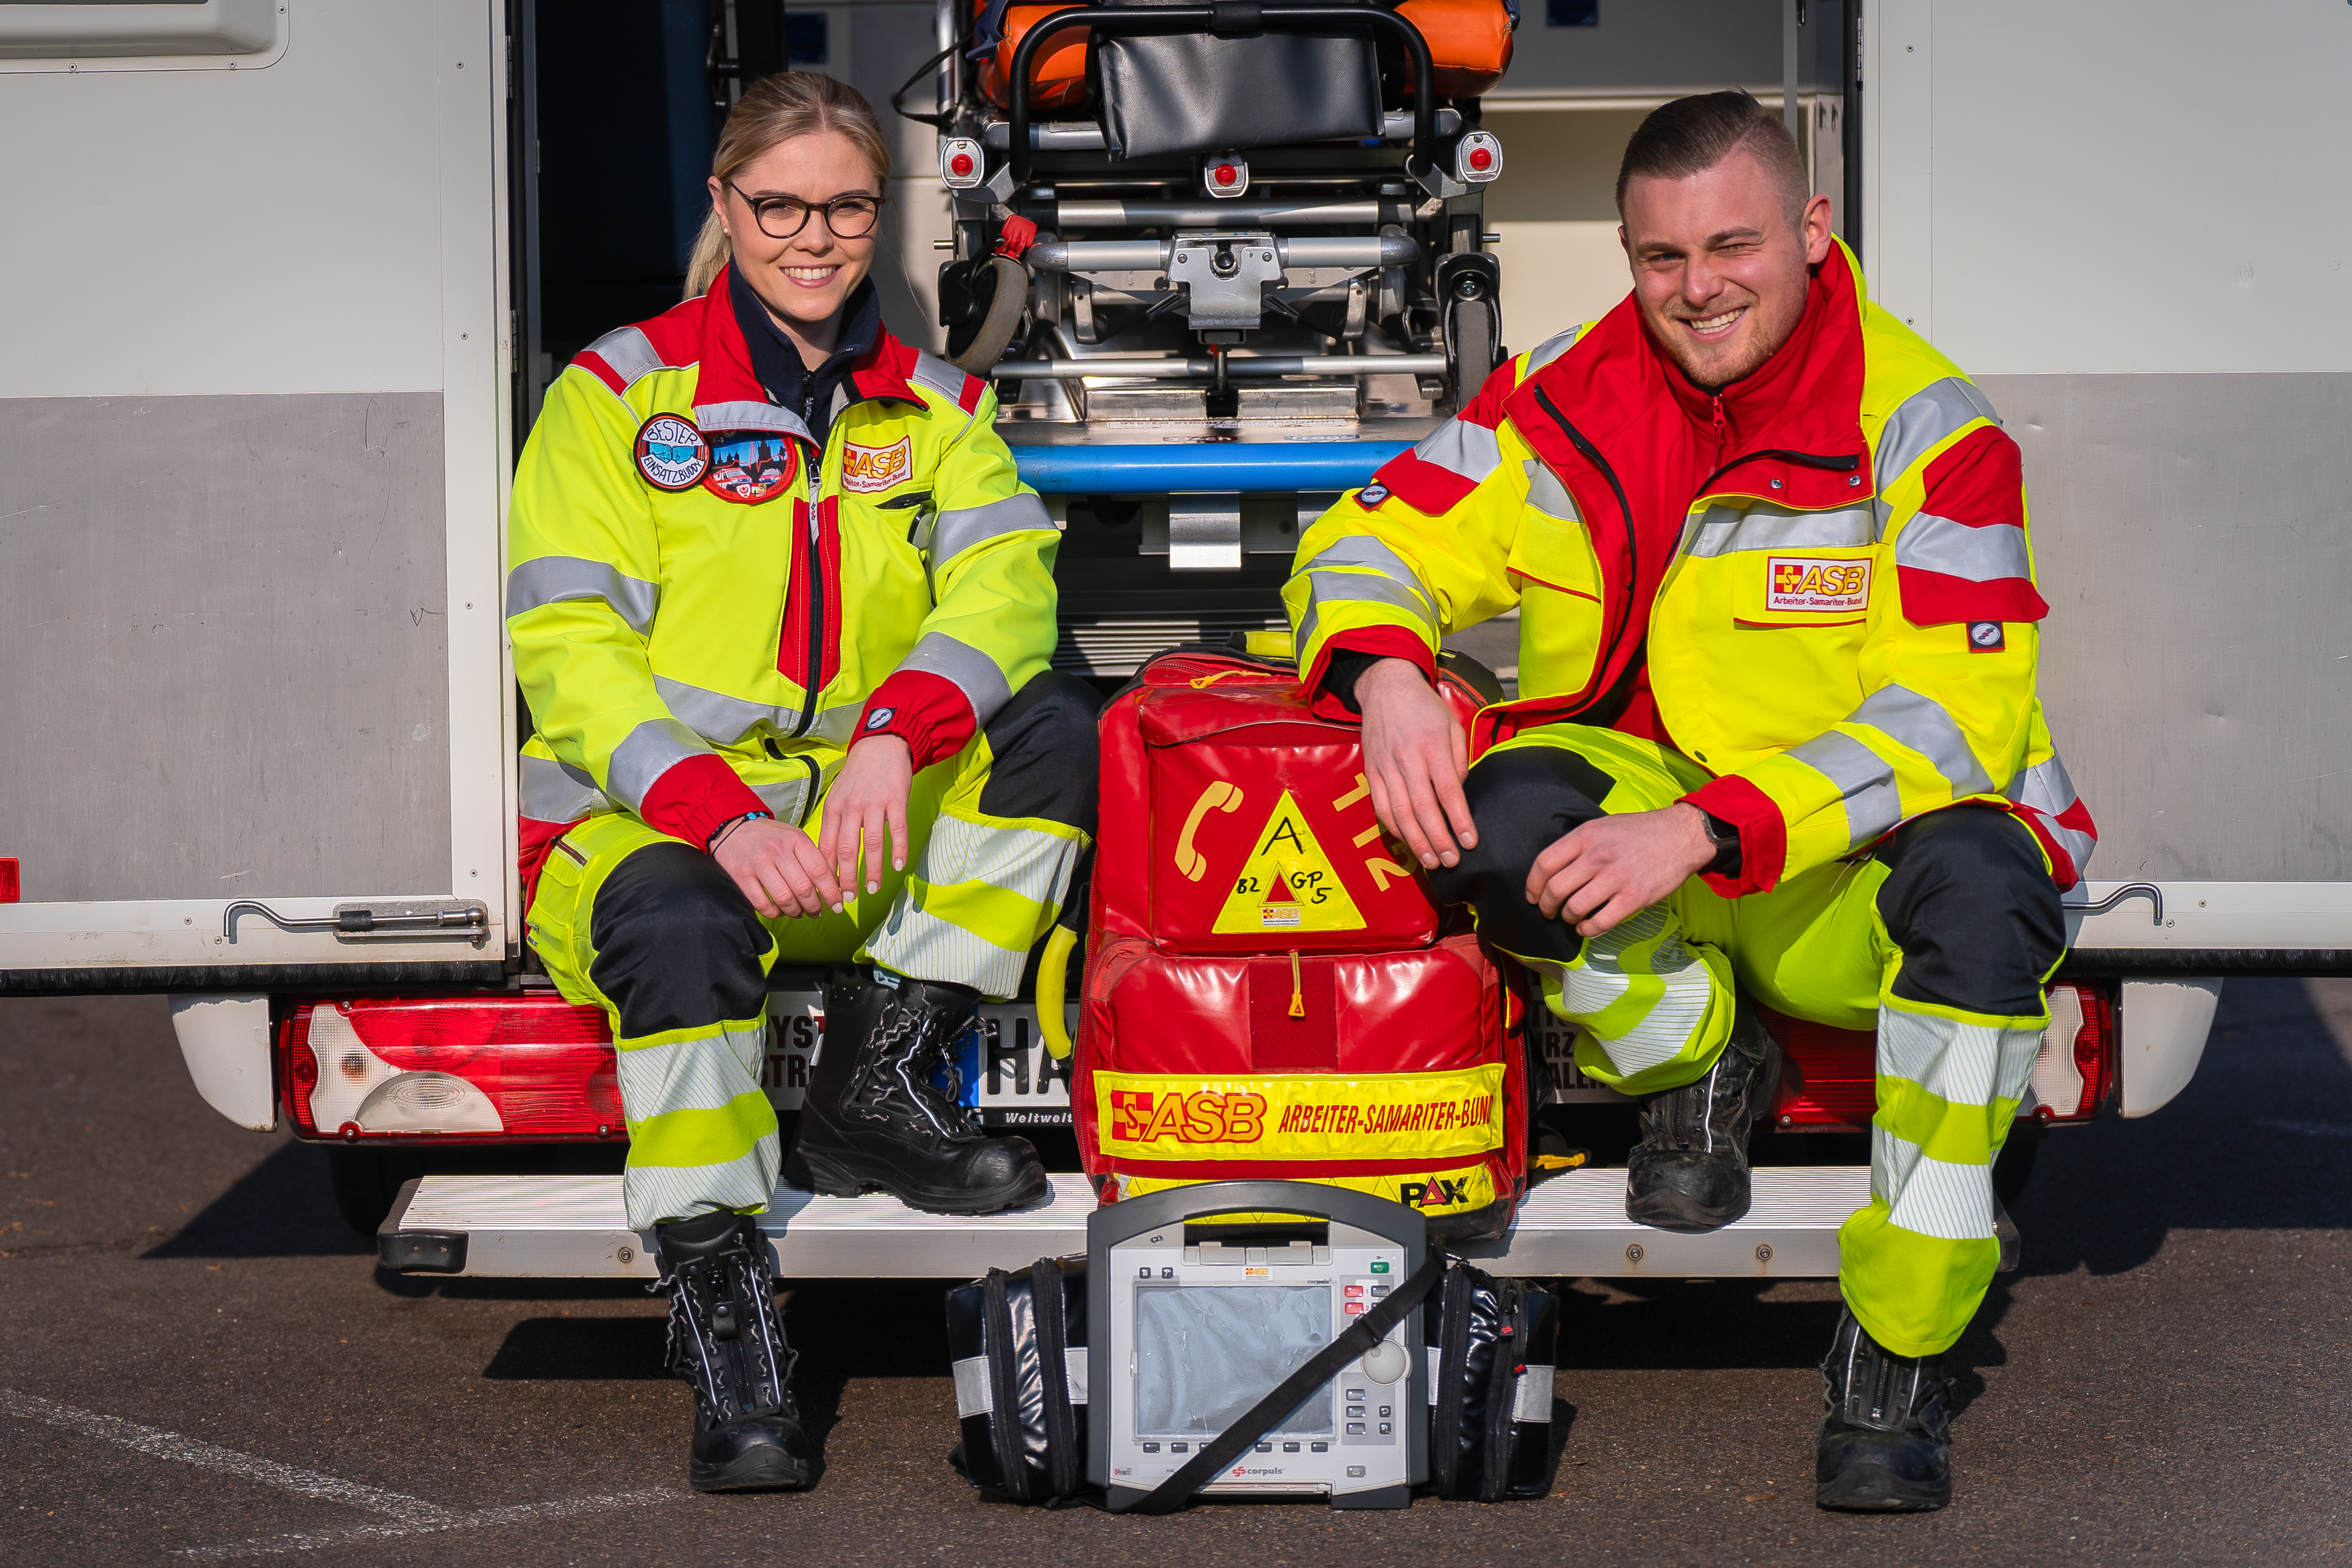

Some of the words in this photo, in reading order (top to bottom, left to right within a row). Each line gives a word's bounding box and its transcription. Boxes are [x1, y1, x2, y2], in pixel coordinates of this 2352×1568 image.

[647, 421, 698, 445] BESTER
[643, 457, 702, 484] EINSATZBUDDY
[852, 445, 906, 480] ASB
[1794, 565, 1866, 597] ASB
[1773, 596, 1863, 606] Arbeiter-Samariter-Bund
[1261, 816, 1304, 856] A
[1333, 772, 1419, 892] 112
[1235, 877, 1261, 894] B2
[1290, 870, 1323, 889] GP
[1272, 908, 1299, 919] ASB
[1006, 1113, 1073, 1123] Weltweit
[1140, 1090, 1268, 1144] ASB
[1277, 1094, 1494, 1134] ARBEITER-SAMARITER-BUND
[1400, 1175, 1470, 1209] PAX
[1247, 1467, 1283, 1476] corpuls
